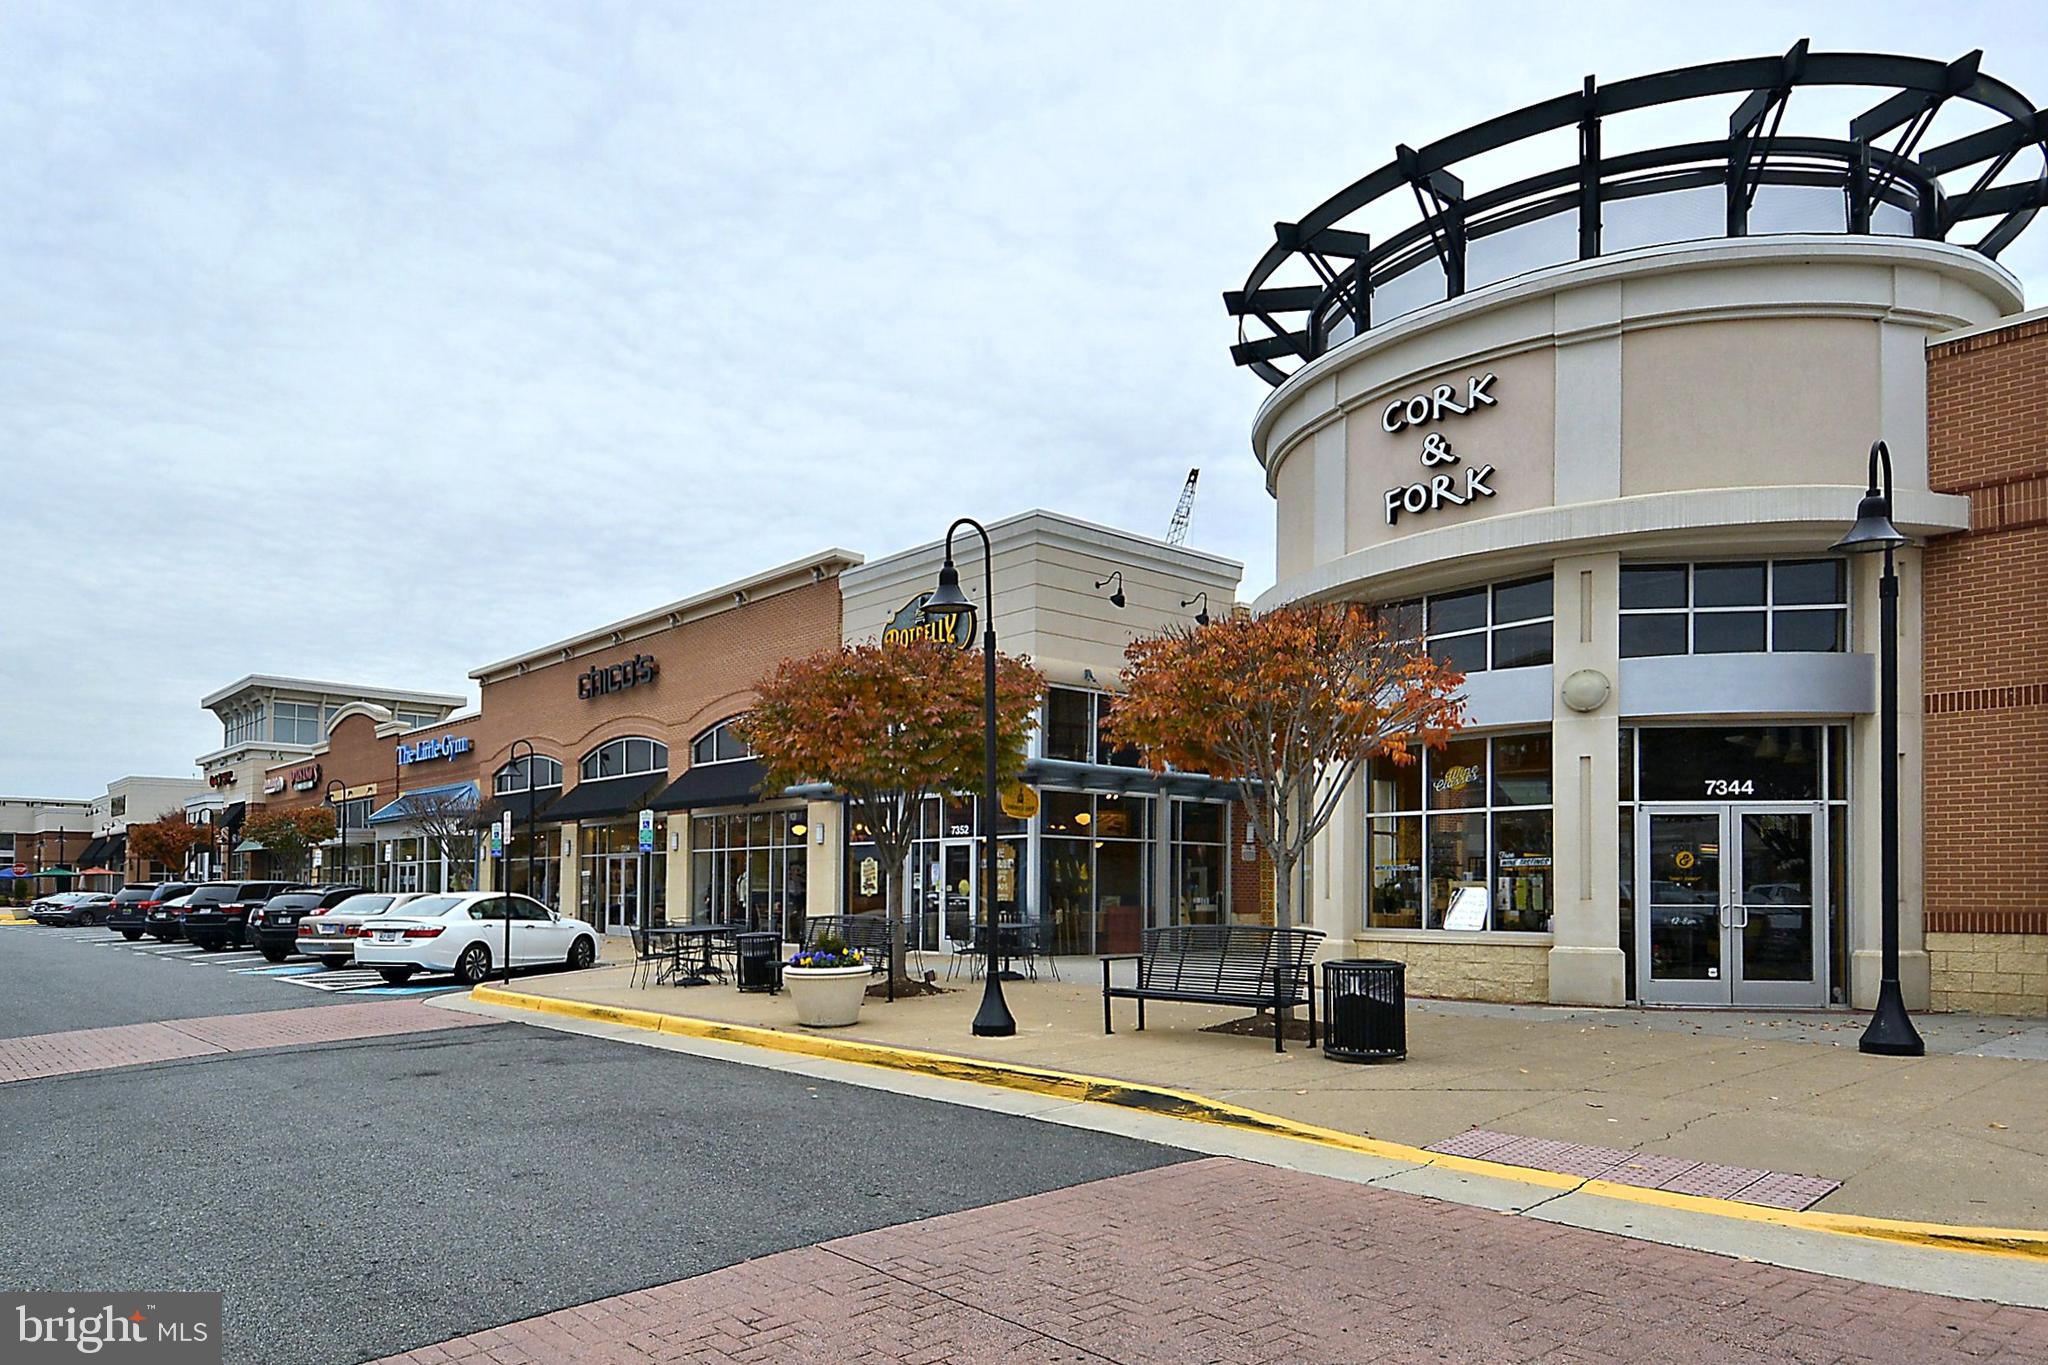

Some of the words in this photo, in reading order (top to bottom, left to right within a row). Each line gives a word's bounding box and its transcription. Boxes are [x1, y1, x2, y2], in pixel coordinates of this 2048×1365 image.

[1381, 373, 1498, 433] CORK
[1420, 431, 1460, 467] &
[1384, 464, 1496, 526] FORK
[396, 745, 415, 765] The
[416, 739, 440, 761] Little
[441, 735, 468, 762] Gym
[1704, 779, 1754, 796] 7344
[950, 825, 970, 835] 7352
